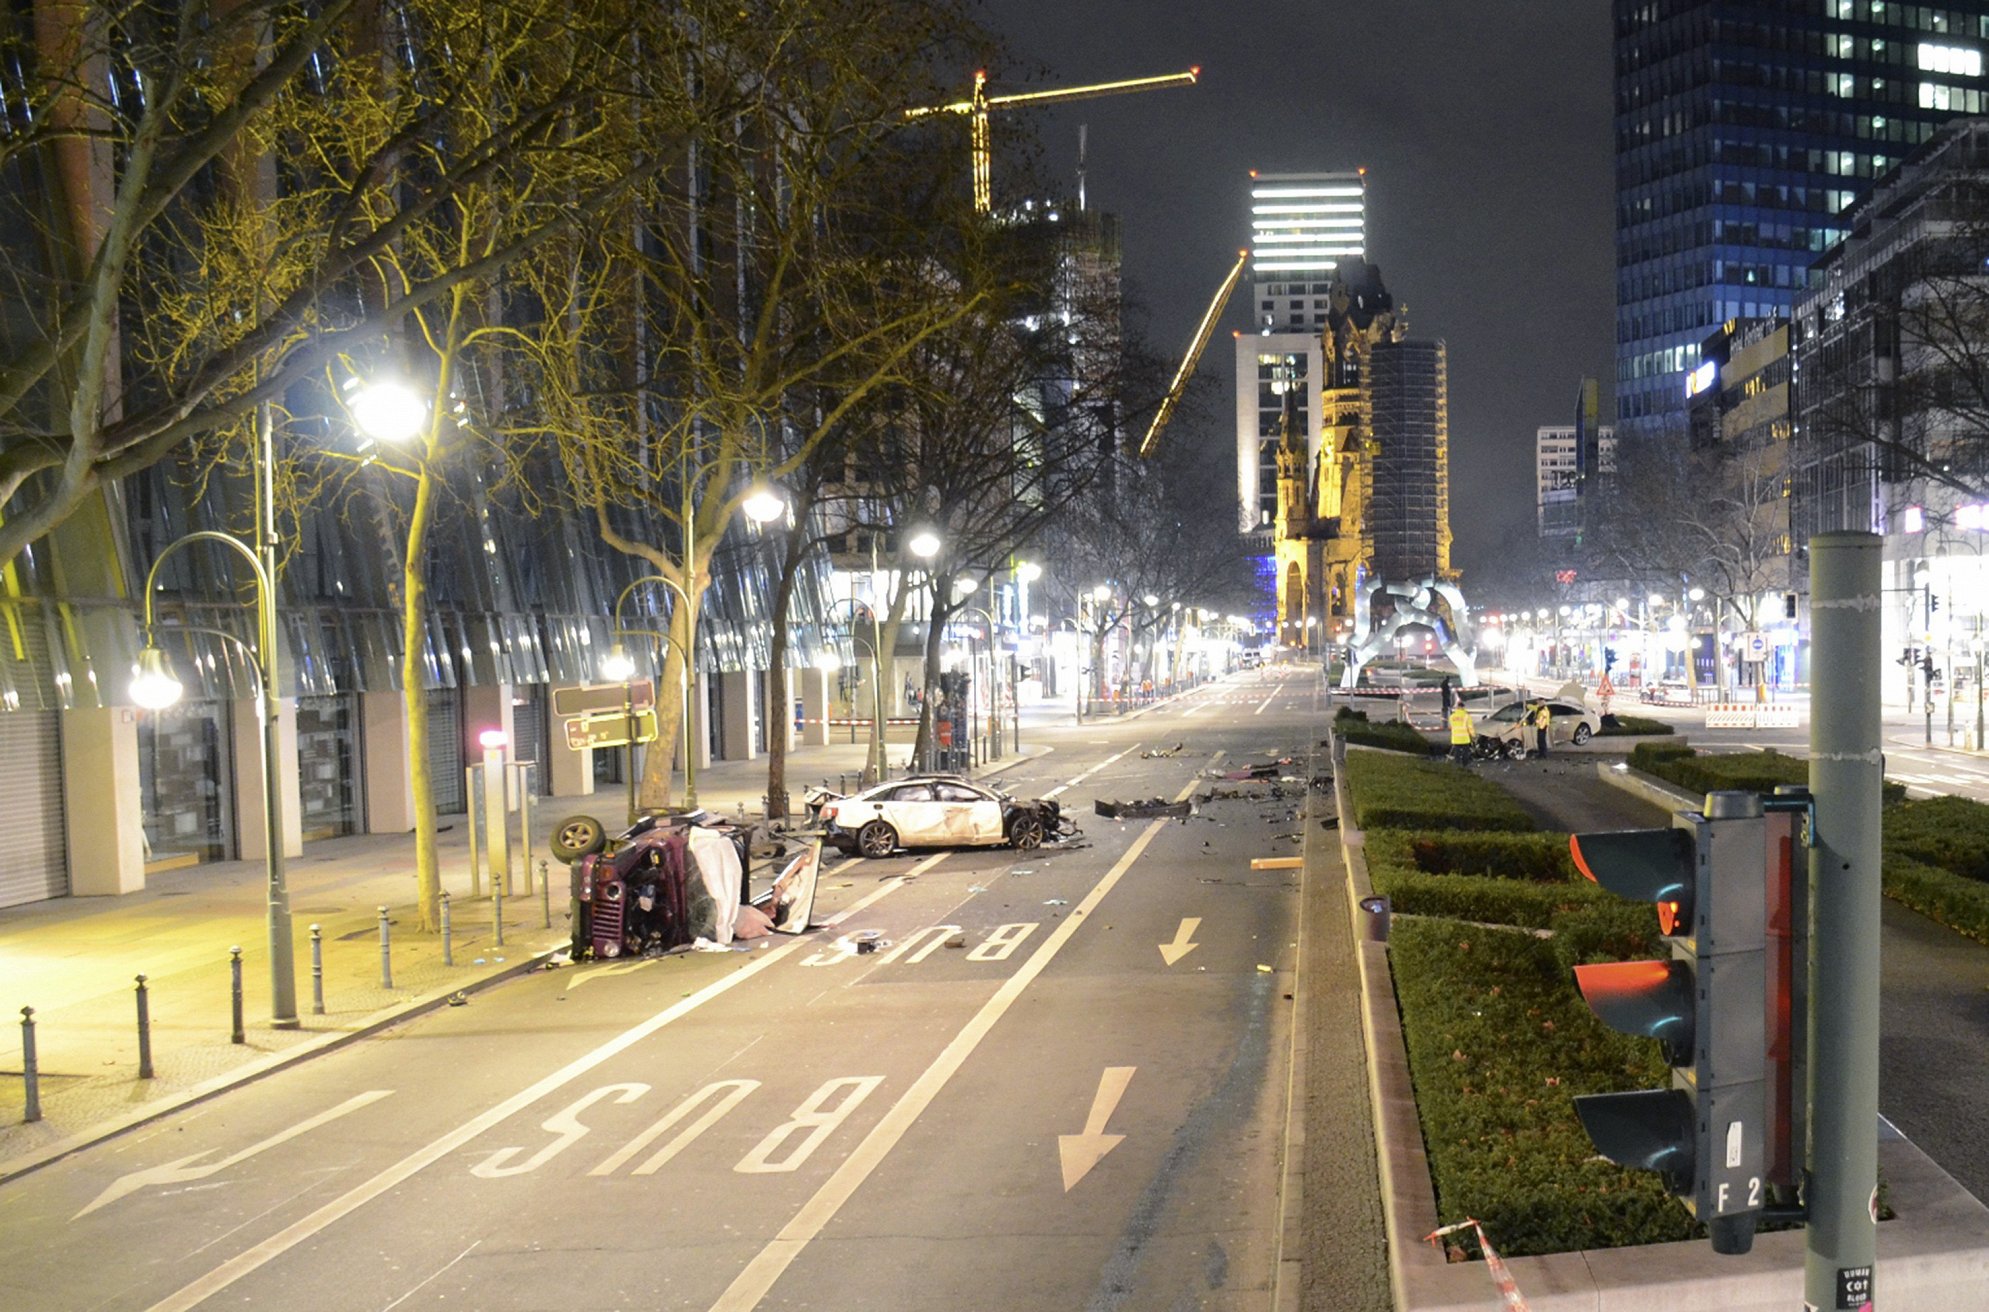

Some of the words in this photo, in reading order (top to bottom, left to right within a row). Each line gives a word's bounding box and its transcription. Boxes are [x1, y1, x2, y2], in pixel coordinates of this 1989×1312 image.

[799, 923, 1040, 966] BUS
[470, 1075, 887, 1178] BUS
[1718, 1183, 1729, 1213] F
[1747, 1177, 1760, 1206] 2
